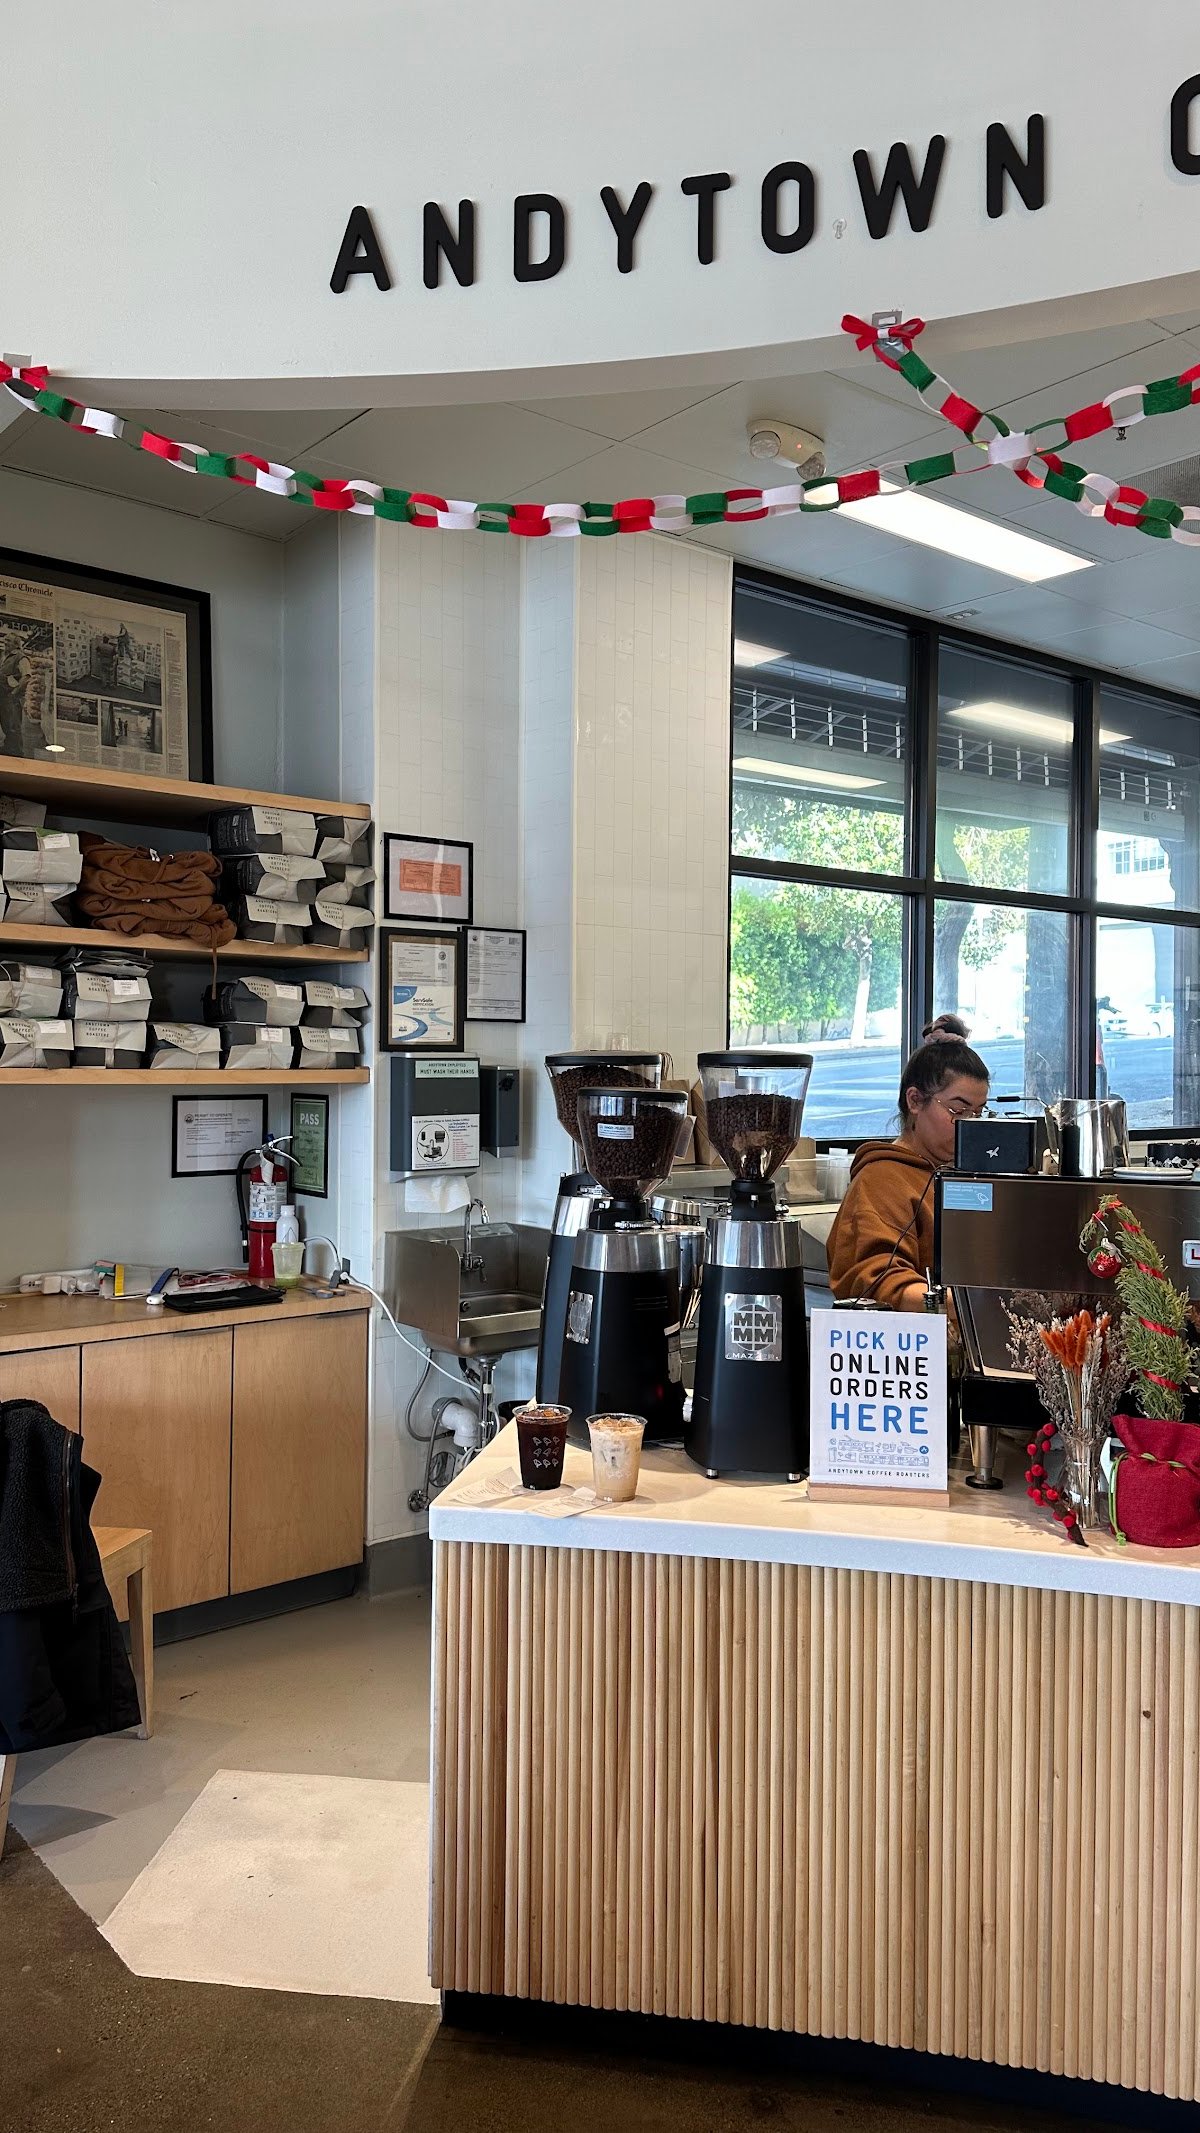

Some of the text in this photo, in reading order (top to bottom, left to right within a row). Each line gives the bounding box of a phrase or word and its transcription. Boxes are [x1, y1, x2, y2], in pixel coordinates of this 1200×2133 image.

[331, 113, 1045, 294] ANDYTOWN
[18, 584, 53, 597] Chronicle
[300, 1113, 319, 1125] PASS
[830, 1330, 929, 1352] PICK UP
[830, 1353, 929, 1377] ONLINE
[830, 1377, 928, 1400] ORDERS
[831, 1402, 929, 1435] HERE
